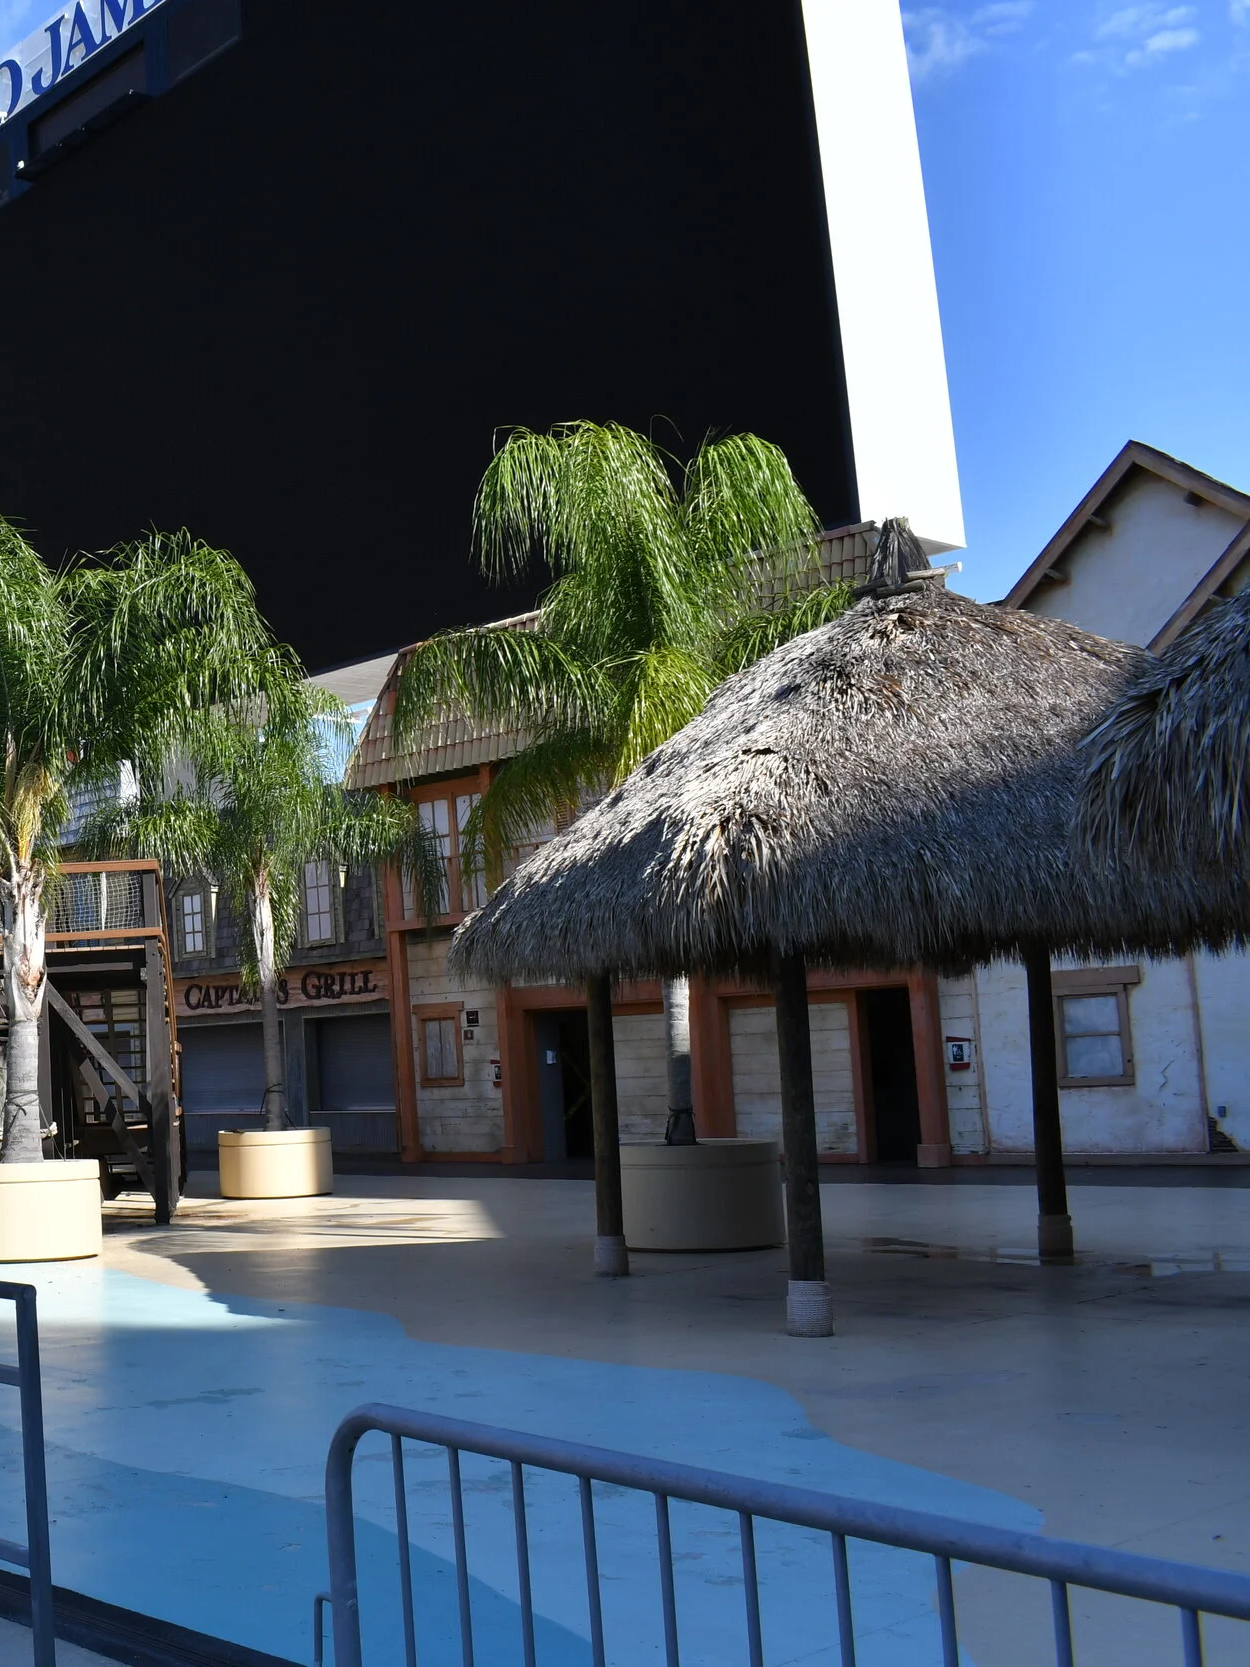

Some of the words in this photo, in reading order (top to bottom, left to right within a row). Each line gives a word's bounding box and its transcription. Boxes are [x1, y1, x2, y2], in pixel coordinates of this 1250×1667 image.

[31, 0, 164, 96] JAM
[184, 978, 290, 1010] CAPTS
[301, 970, 378, 1000] GRILL
